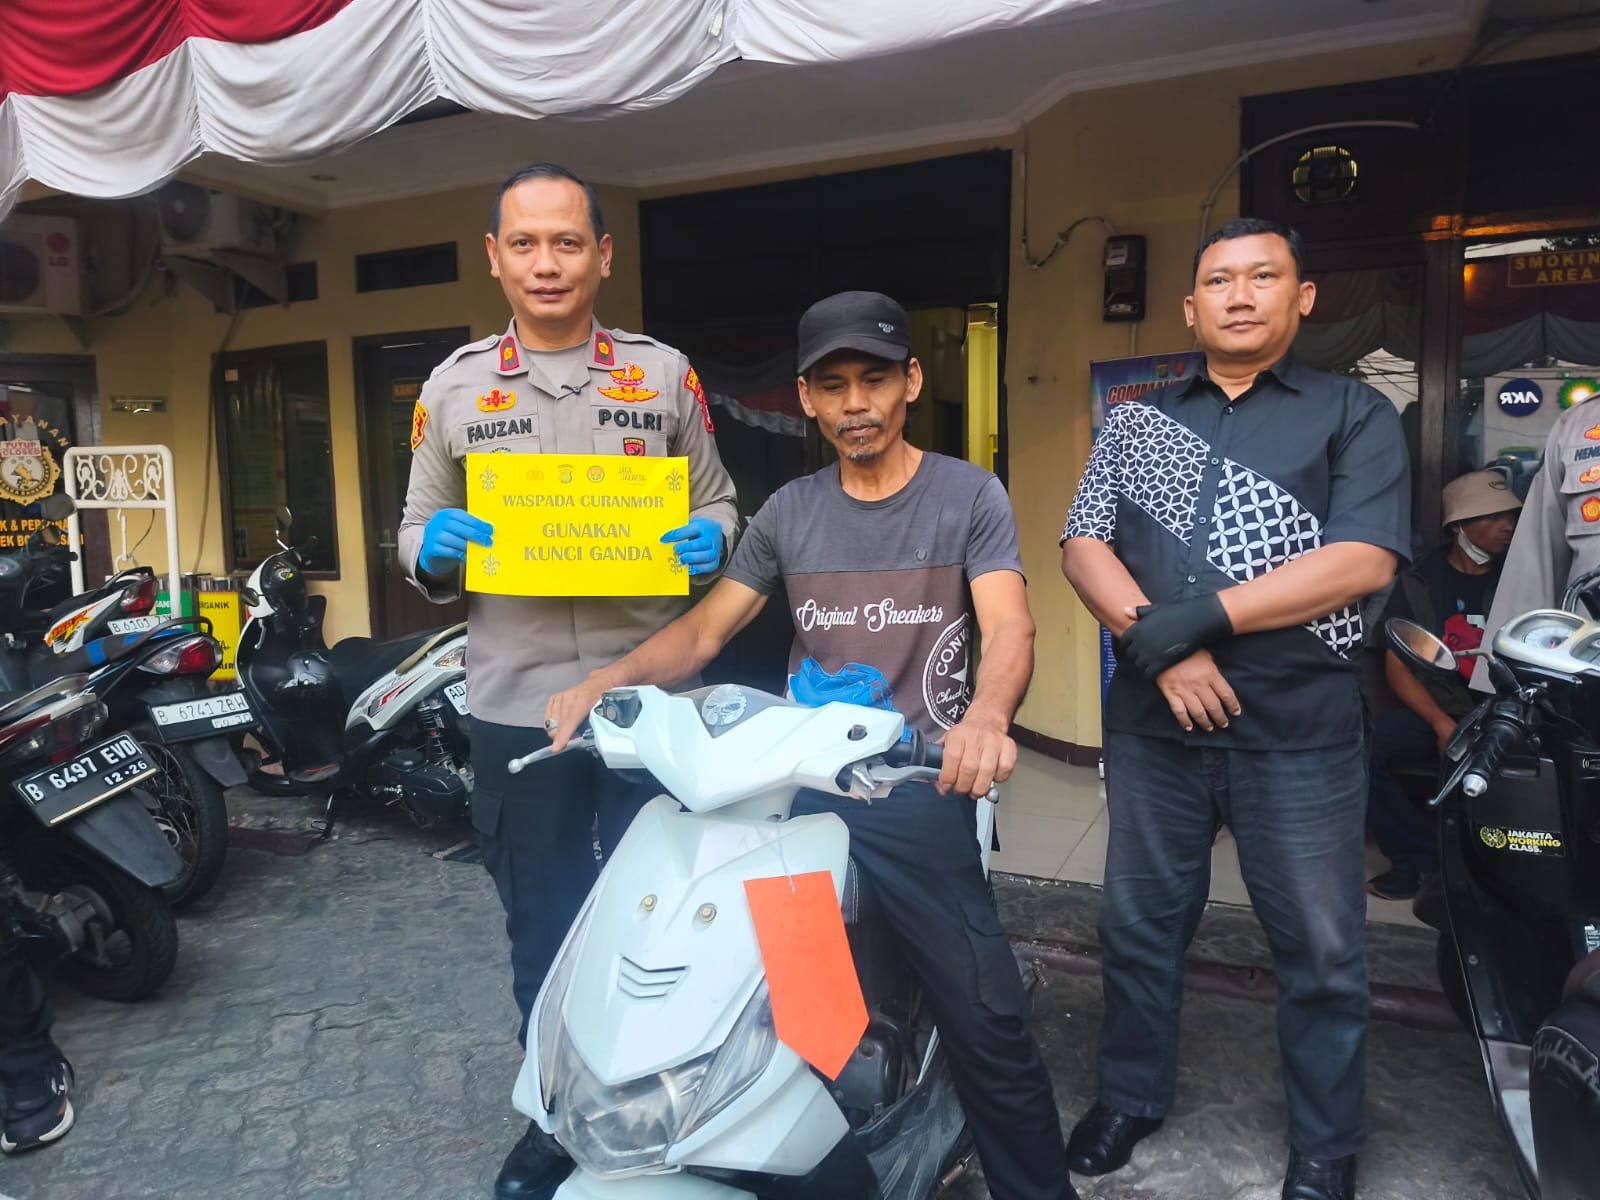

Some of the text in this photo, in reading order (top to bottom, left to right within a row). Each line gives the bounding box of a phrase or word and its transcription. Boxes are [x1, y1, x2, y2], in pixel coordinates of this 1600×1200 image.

[1536, 268, 1593, 284] AREA
[599, 409, 662, 431] POLRI
[467, 418, 532, 443] FAUZAN
[503, 494, 664, 509] WASPADA CURANMOR
[542, 523, 630, 538] GUNAKAN
[524, 546, 652, 562] KUNCI GANDA
[796, 598, 943, 632] Original Sneakers
[112, 623, 121, 633] B
[157, 710, 168, 723] B
[179, 702, 214, 720] 6741
[25, 783, 44, 801] B
[49, 757, 98, 790] 6497
[1507, 830, 1553, 840] JAKARTA
[1507, 837, 1561, 847] WORKING
